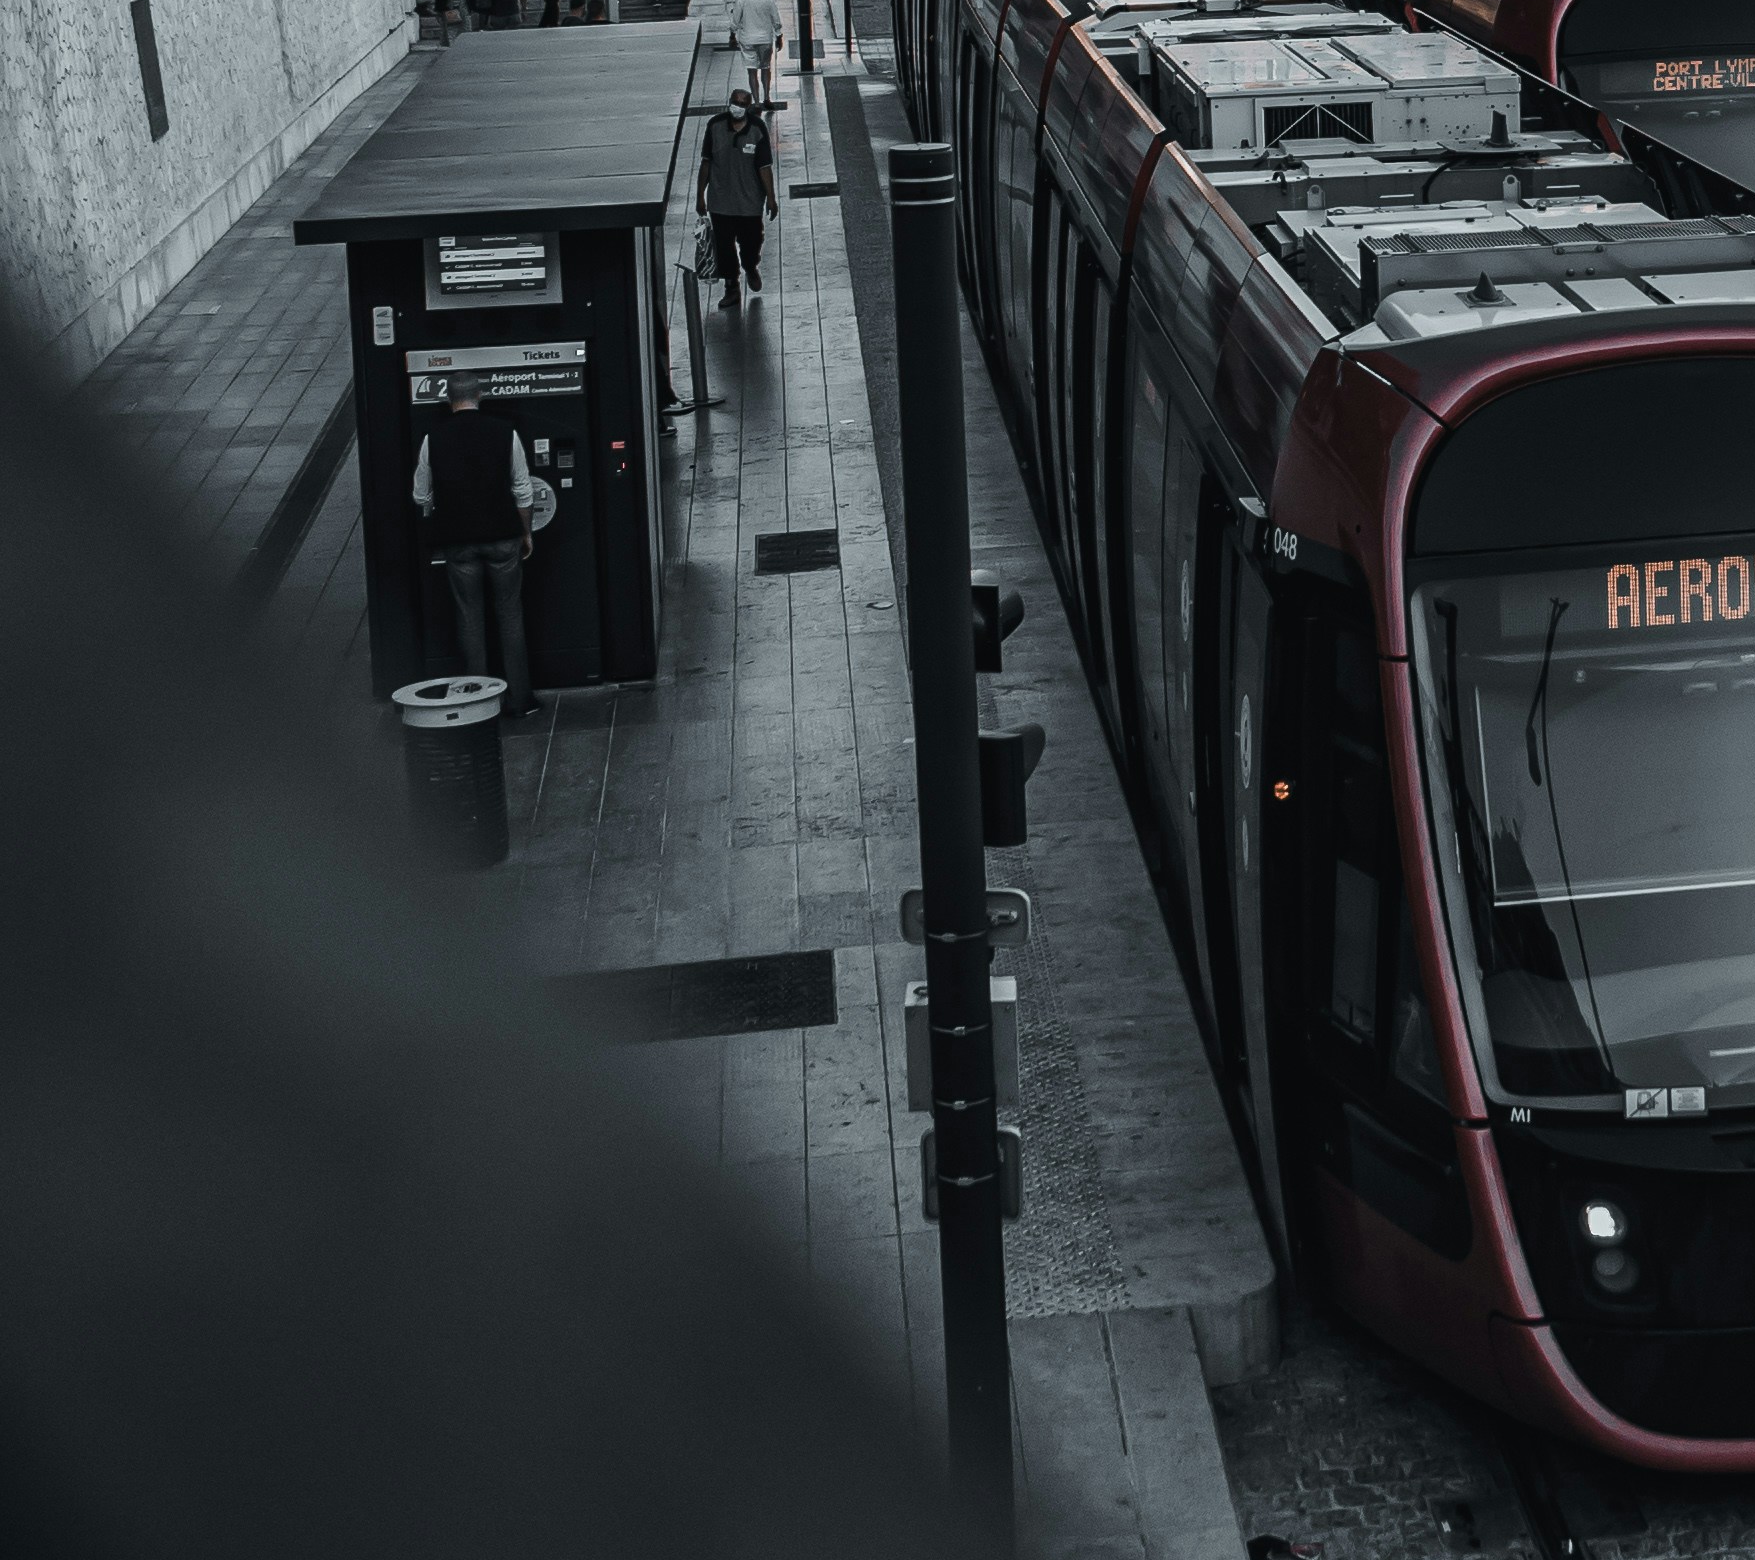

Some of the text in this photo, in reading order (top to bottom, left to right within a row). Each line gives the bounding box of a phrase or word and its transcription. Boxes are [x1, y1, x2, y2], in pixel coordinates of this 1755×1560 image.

[1655, 60, 1703, 77] PORT
[523, 350, 561, 361] Tickets
[491, 372, 537, 384] Aéroport
[437, 378, 448, 397] 2
[491, 384, 531, 396] CADAM
[1274, 526, 1298, 561] 048
